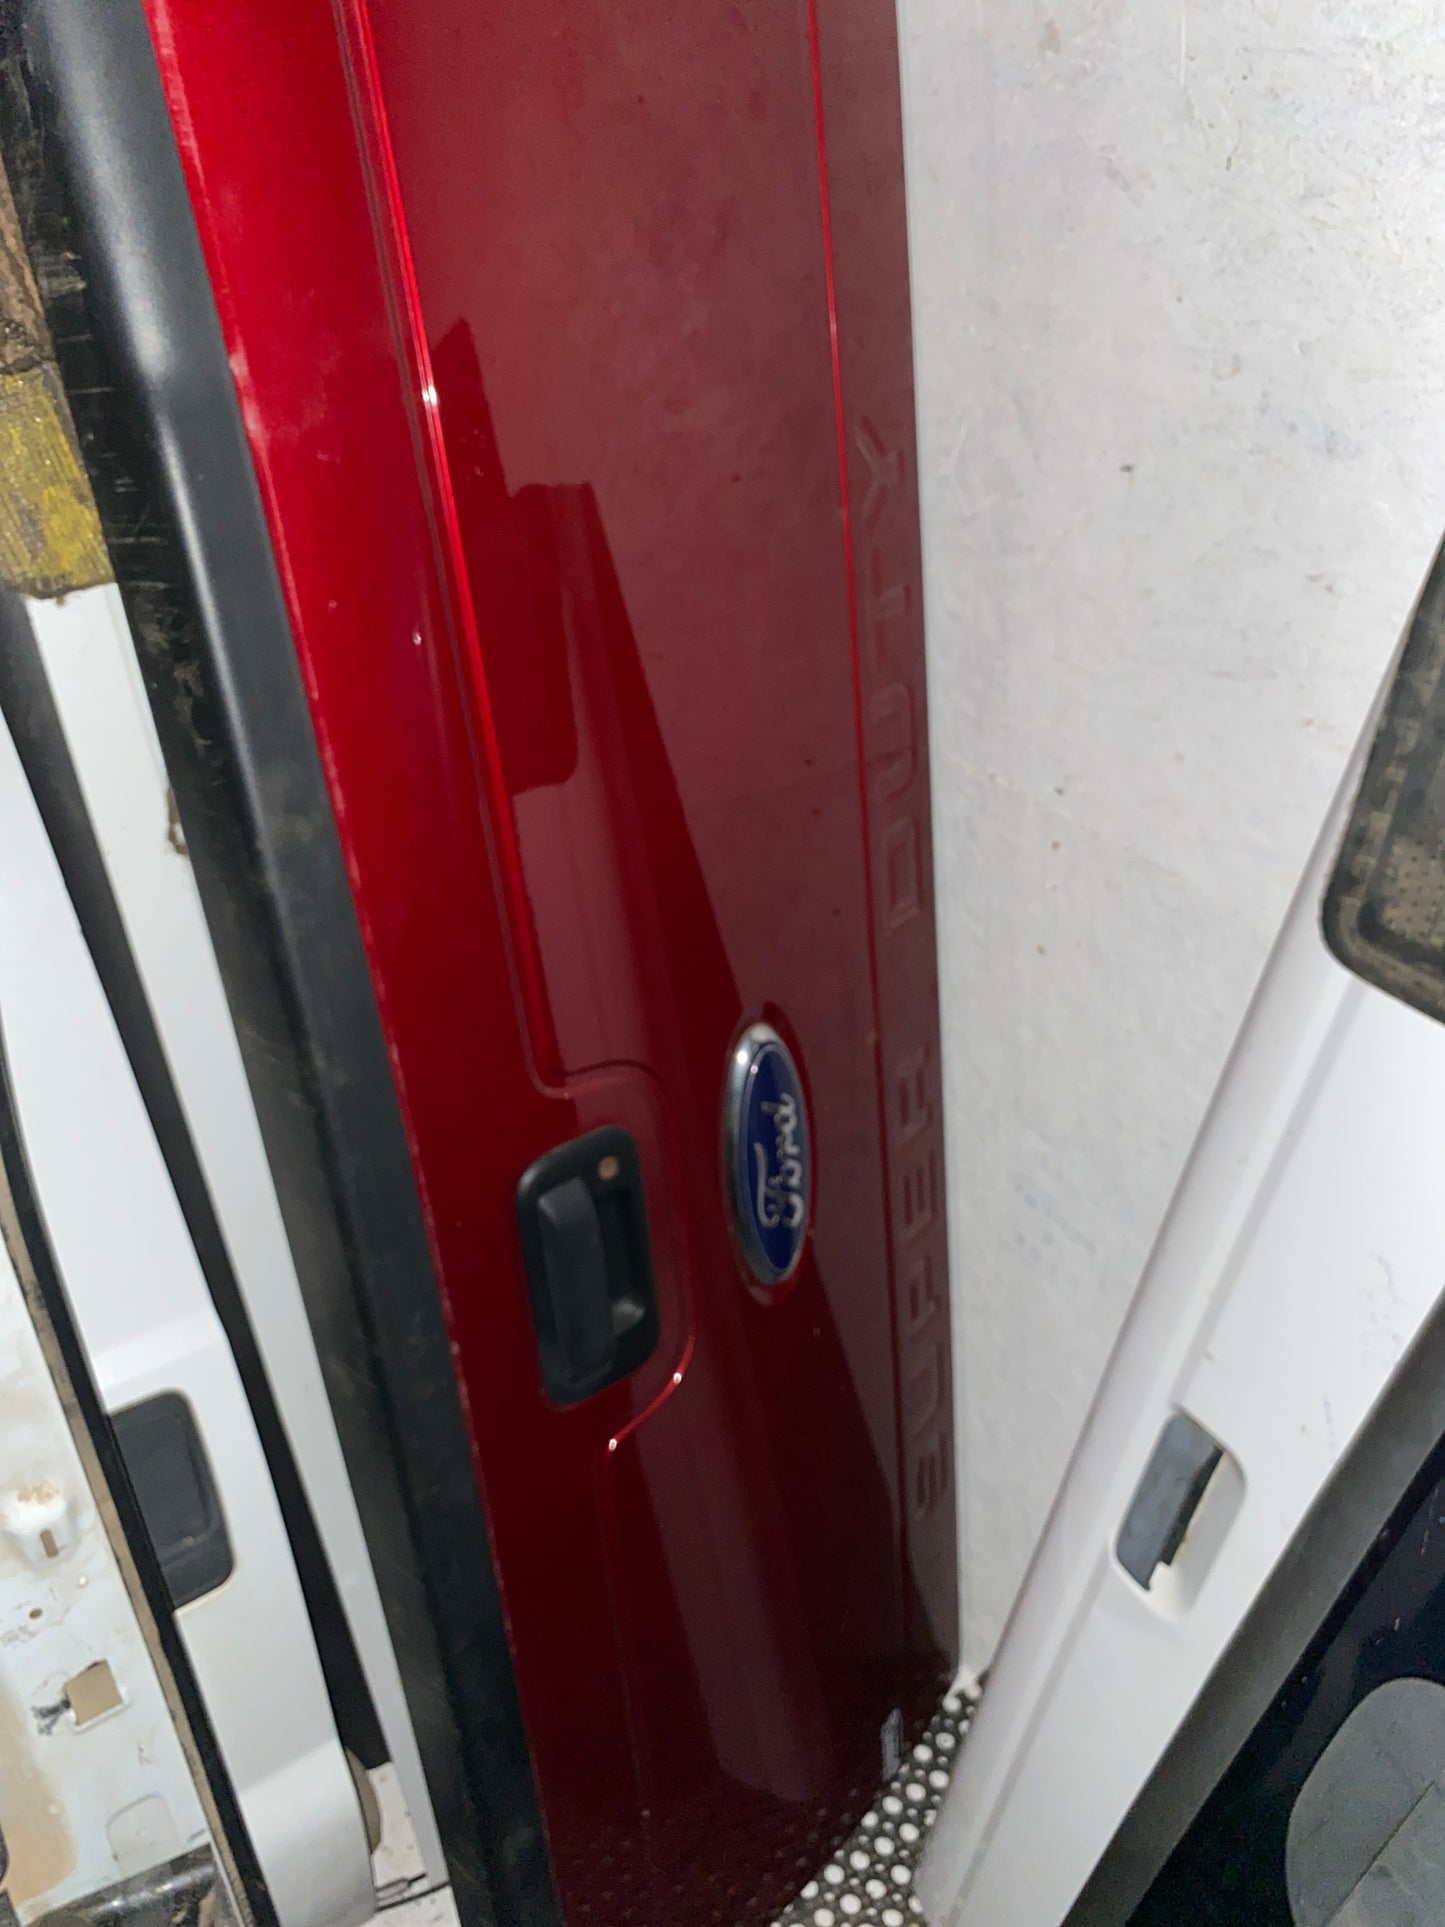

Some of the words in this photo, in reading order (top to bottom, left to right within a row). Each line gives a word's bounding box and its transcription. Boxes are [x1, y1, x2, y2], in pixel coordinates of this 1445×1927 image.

[855, 415, 925, 933] DUTY
[754, 1092, 803, 1230] Ford
[897, 1040, 949, 1521] SUPER
